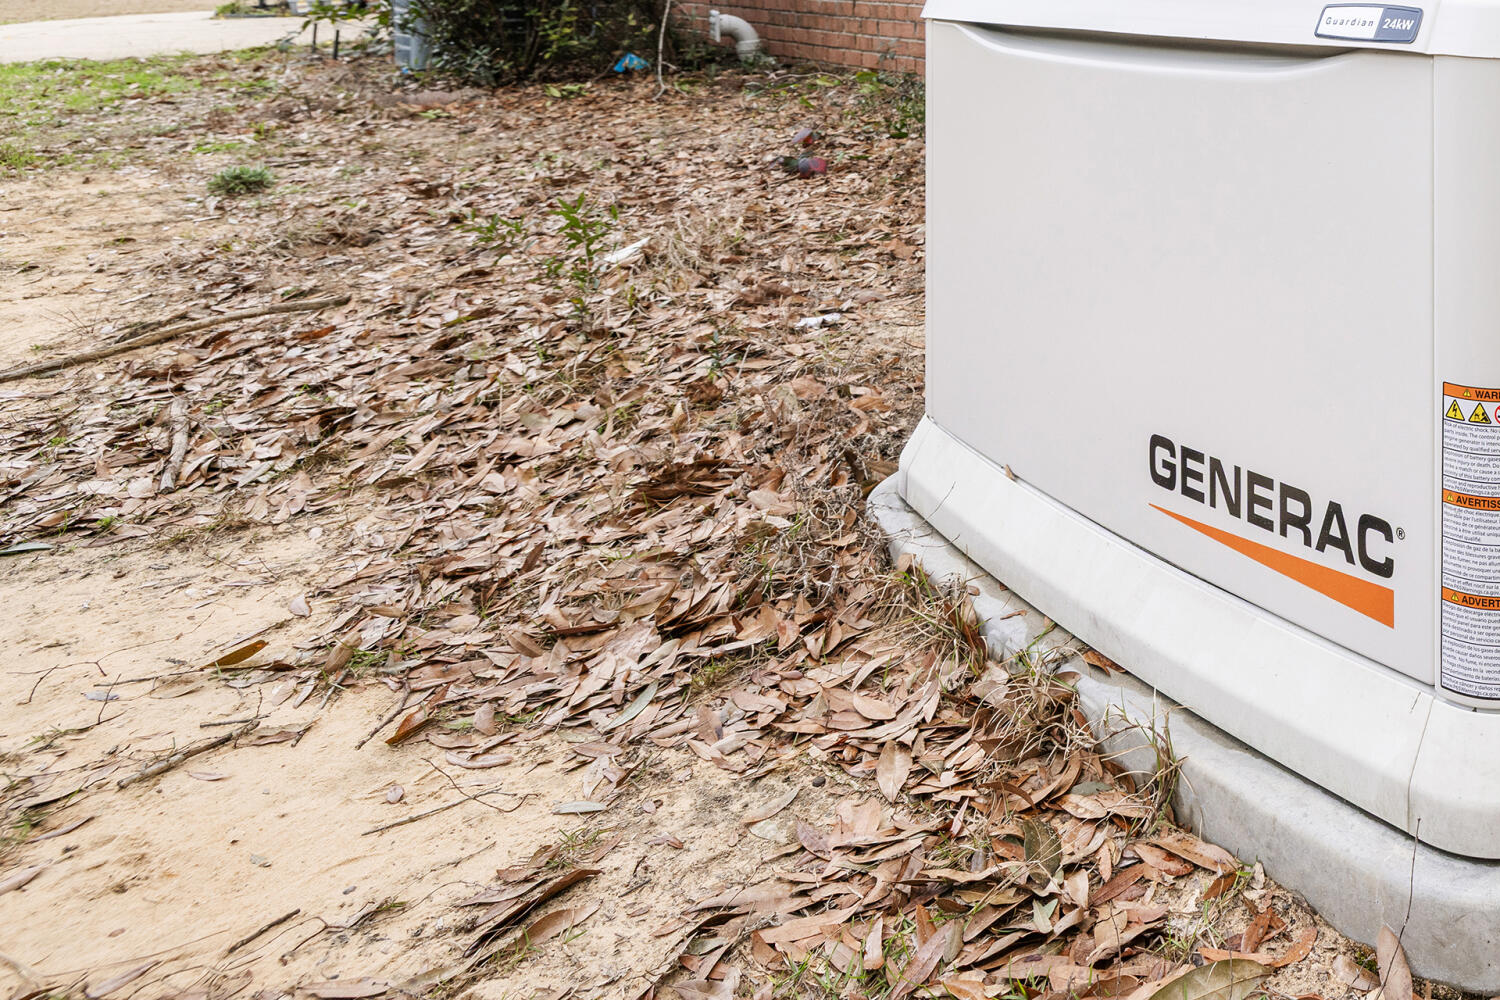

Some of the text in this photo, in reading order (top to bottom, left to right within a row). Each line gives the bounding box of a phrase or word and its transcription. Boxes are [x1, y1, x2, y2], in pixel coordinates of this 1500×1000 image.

[1325, 17, 1374, 27] Guardian
[1383, 18, 1415, 30] 24kW
[1467, 482, 1497, 490] reproductive
[1149, 433, 1394, 579] GENERAC
